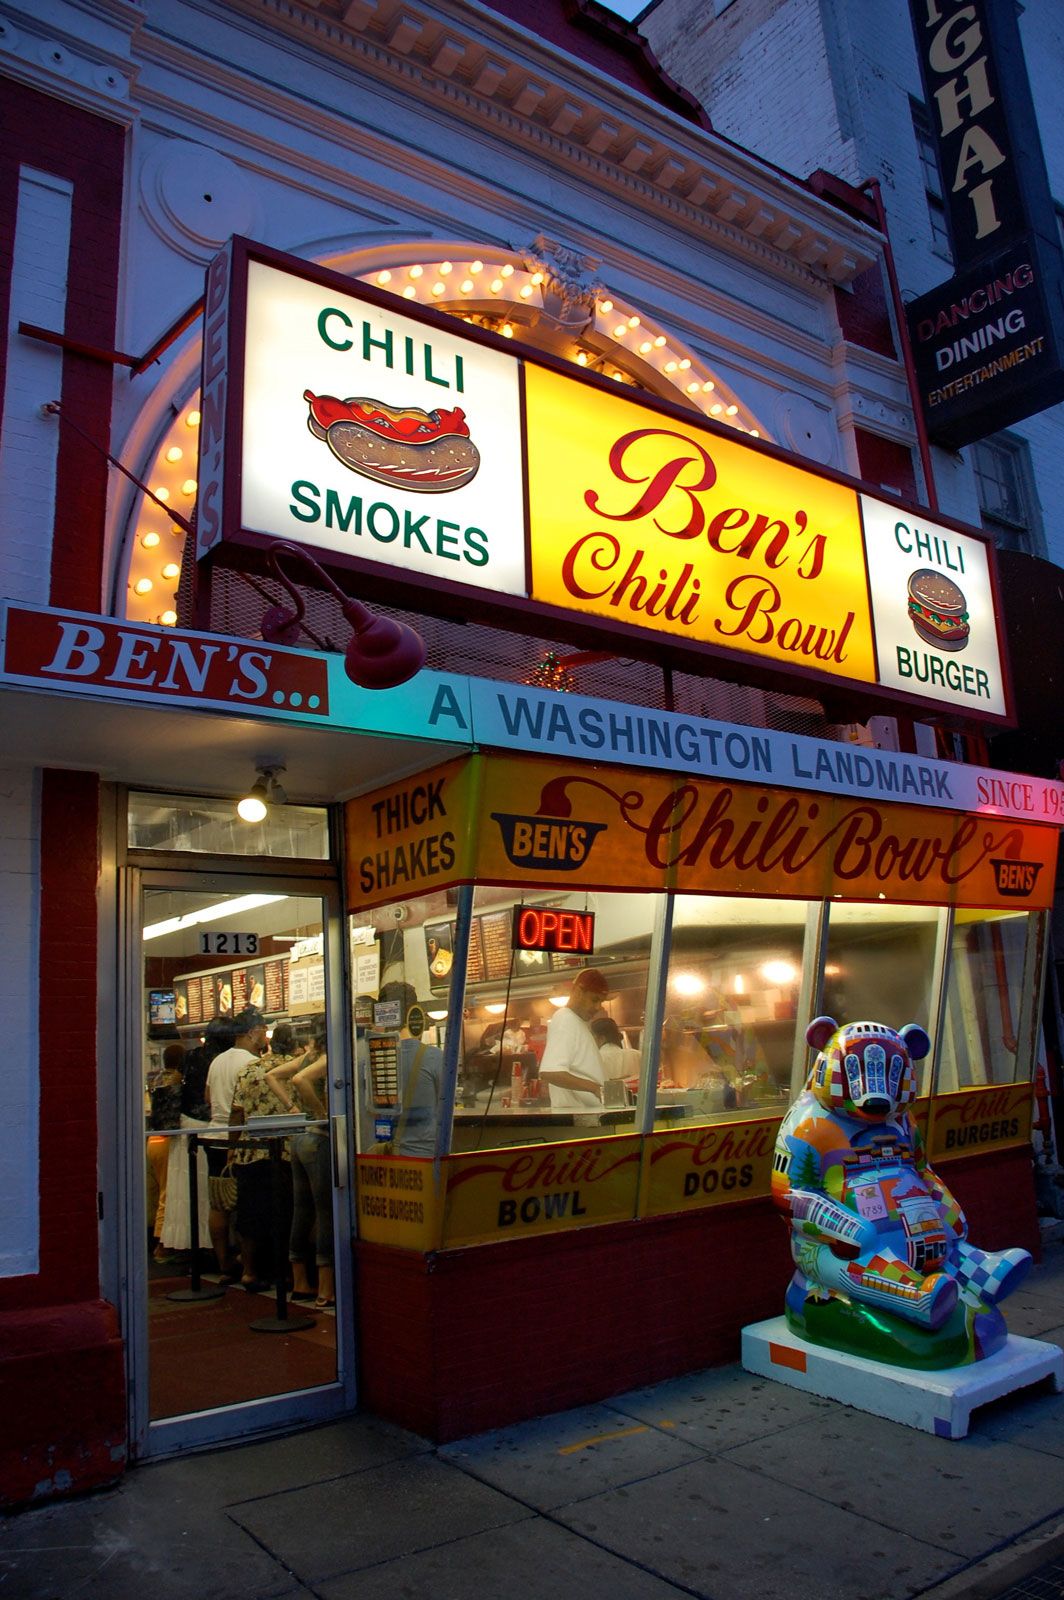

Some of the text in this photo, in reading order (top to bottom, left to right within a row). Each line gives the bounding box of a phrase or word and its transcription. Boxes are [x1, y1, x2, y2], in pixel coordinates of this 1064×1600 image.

[918, 264, 1034, 342] DANCING
[317, 307, 464, 394] CHILI
[935, 309, 1026, 372] DINING
[928, 336, 1044, 407] ENTERTAINMENT
[289, 480, 490, 567] SMOKES
[584, 428, 827, 580] Ben's
[894, 522, 966, 574] CHILI
[562, 532, 855, 664] Chili Bowl
[897, 645, 991, 700] BURGER
[428, 684, 953, 799] A WASHINGTON LANDMARK
[372, 778, 448, 839] THICK
[977, 776, 1034, 812] SINCE
[513, 822, 587, 862] BEN'S
[644, 785, 985, 884] Chili Bowl
[360, 832, 456, 893] SHAKES
[202, 932, 258, 954] 1213
[519, 911, 591, 950] OPEN
[692, 1127, 774, 1166] Chili
[945, 1117, 1019, 1149] BURGERS
[359, 1164, 423, 1192] TURKEY BURGERS
[502, 1149, 605, 1192] Chili
[684, 1164, 753, 1196] DOGS
[360, 1195, 423, 1224] VEGGIE BURGERS
[497, 1190, 586, 1227] BOWL
